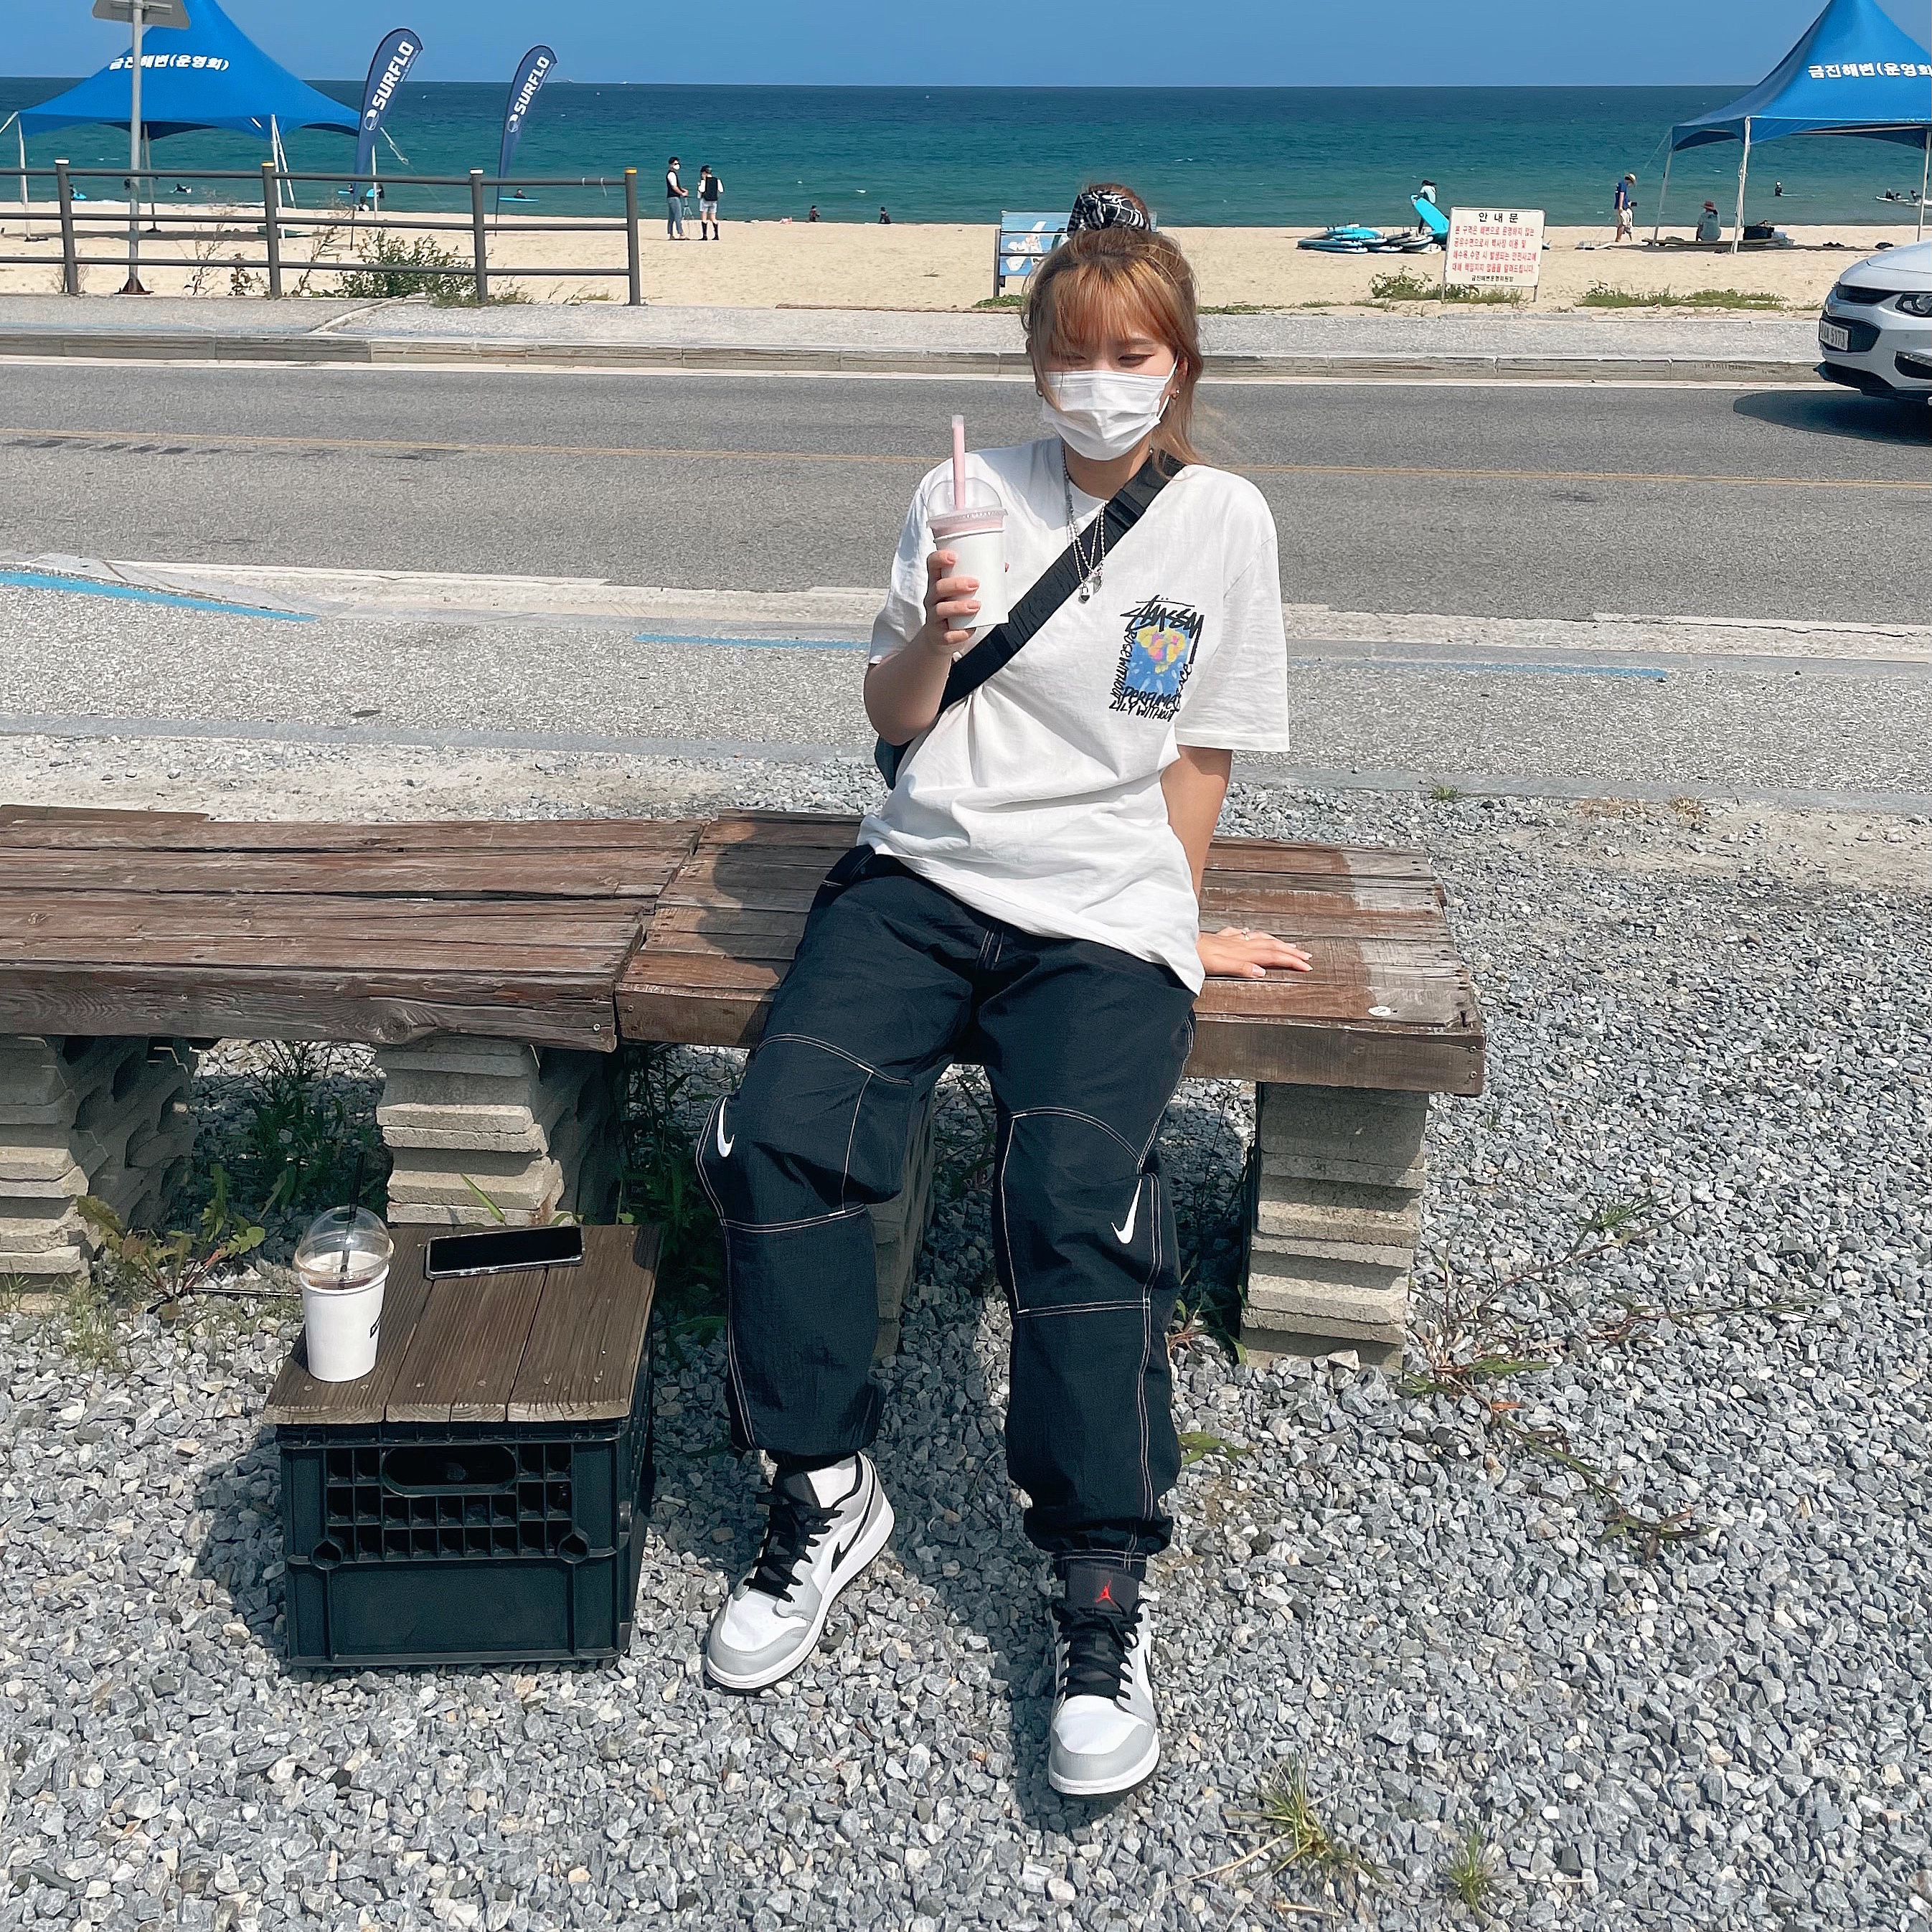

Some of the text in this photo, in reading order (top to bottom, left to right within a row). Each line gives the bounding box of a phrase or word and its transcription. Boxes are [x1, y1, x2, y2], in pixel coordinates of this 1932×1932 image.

[372, 39, 415, 110] SURFLO
[514, 56, 550, 116] SURFLO
[1136, 705, 1176, 722] WITHOUT
